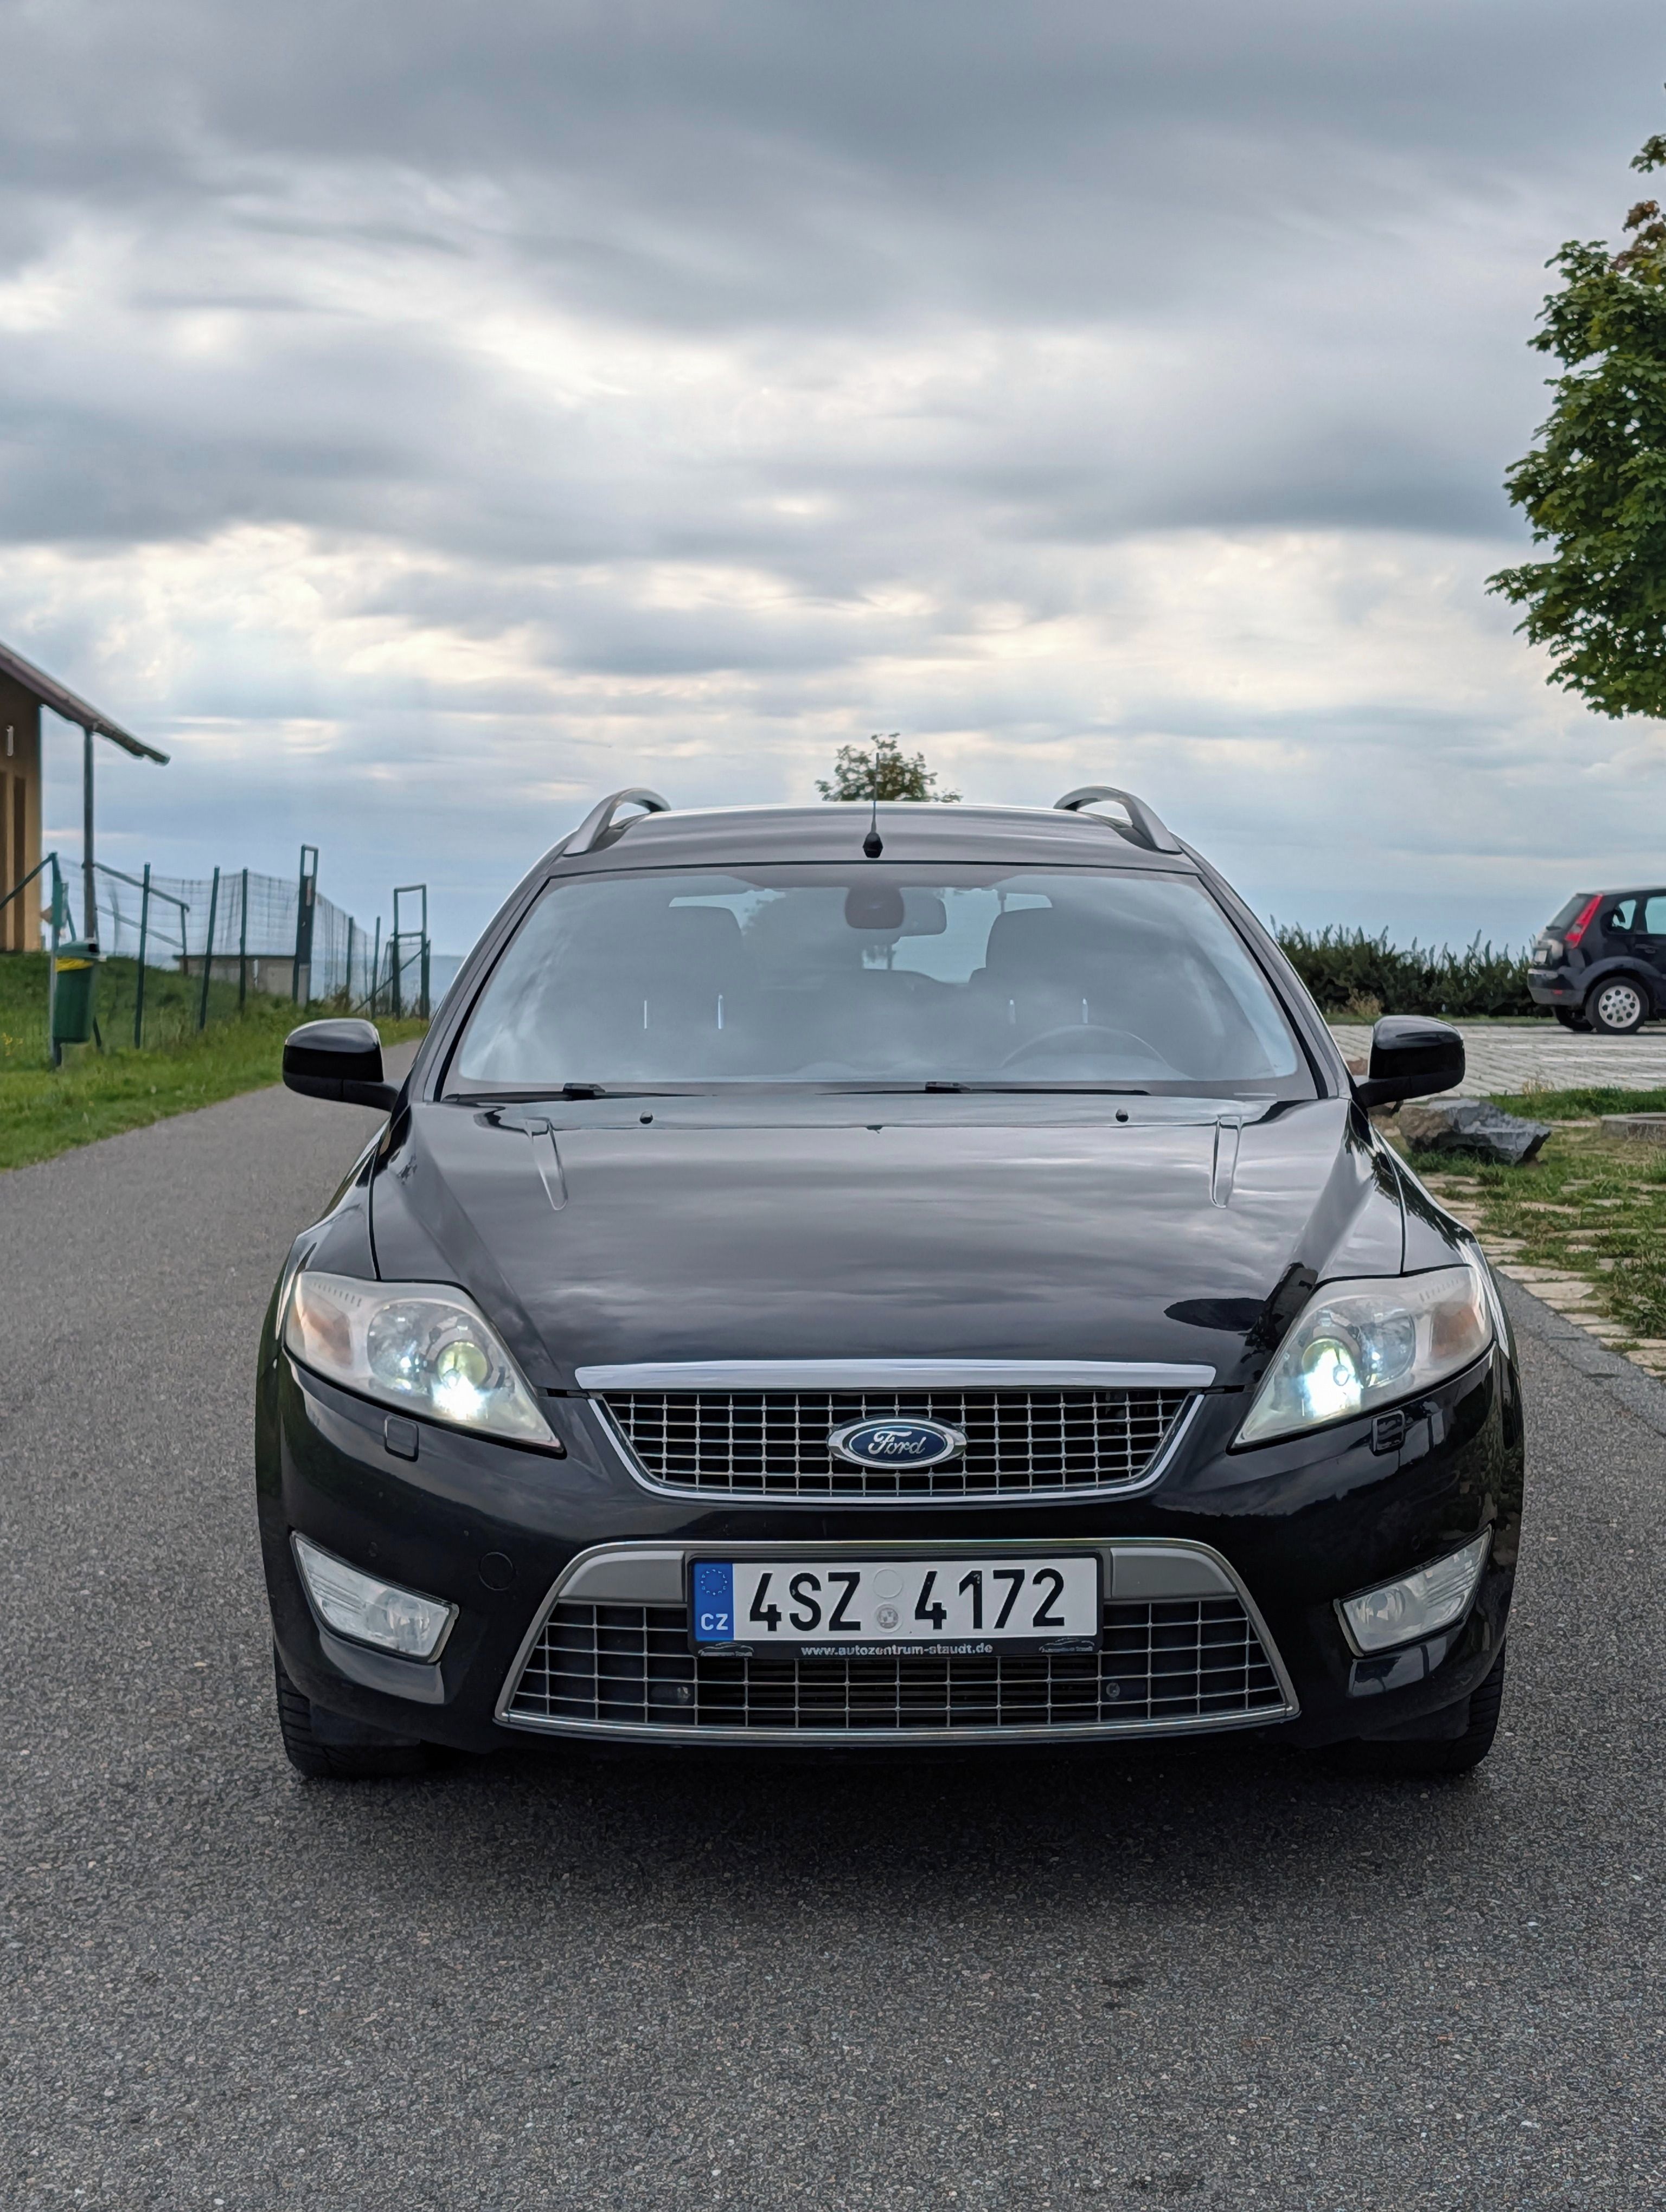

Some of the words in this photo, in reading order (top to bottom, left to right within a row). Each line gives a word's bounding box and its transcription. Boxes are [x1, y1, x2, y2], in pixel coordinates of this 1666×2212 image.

[869, 1431, 926, 1454] Ford
[749, 1572, 861, 1631] 4SZ
[915, 1568, 1065, 1629] 4172
[701, 1613, 728, 1630] CZ
[801, 1642, 993, 1656] www.autozentrum-staudt.de
